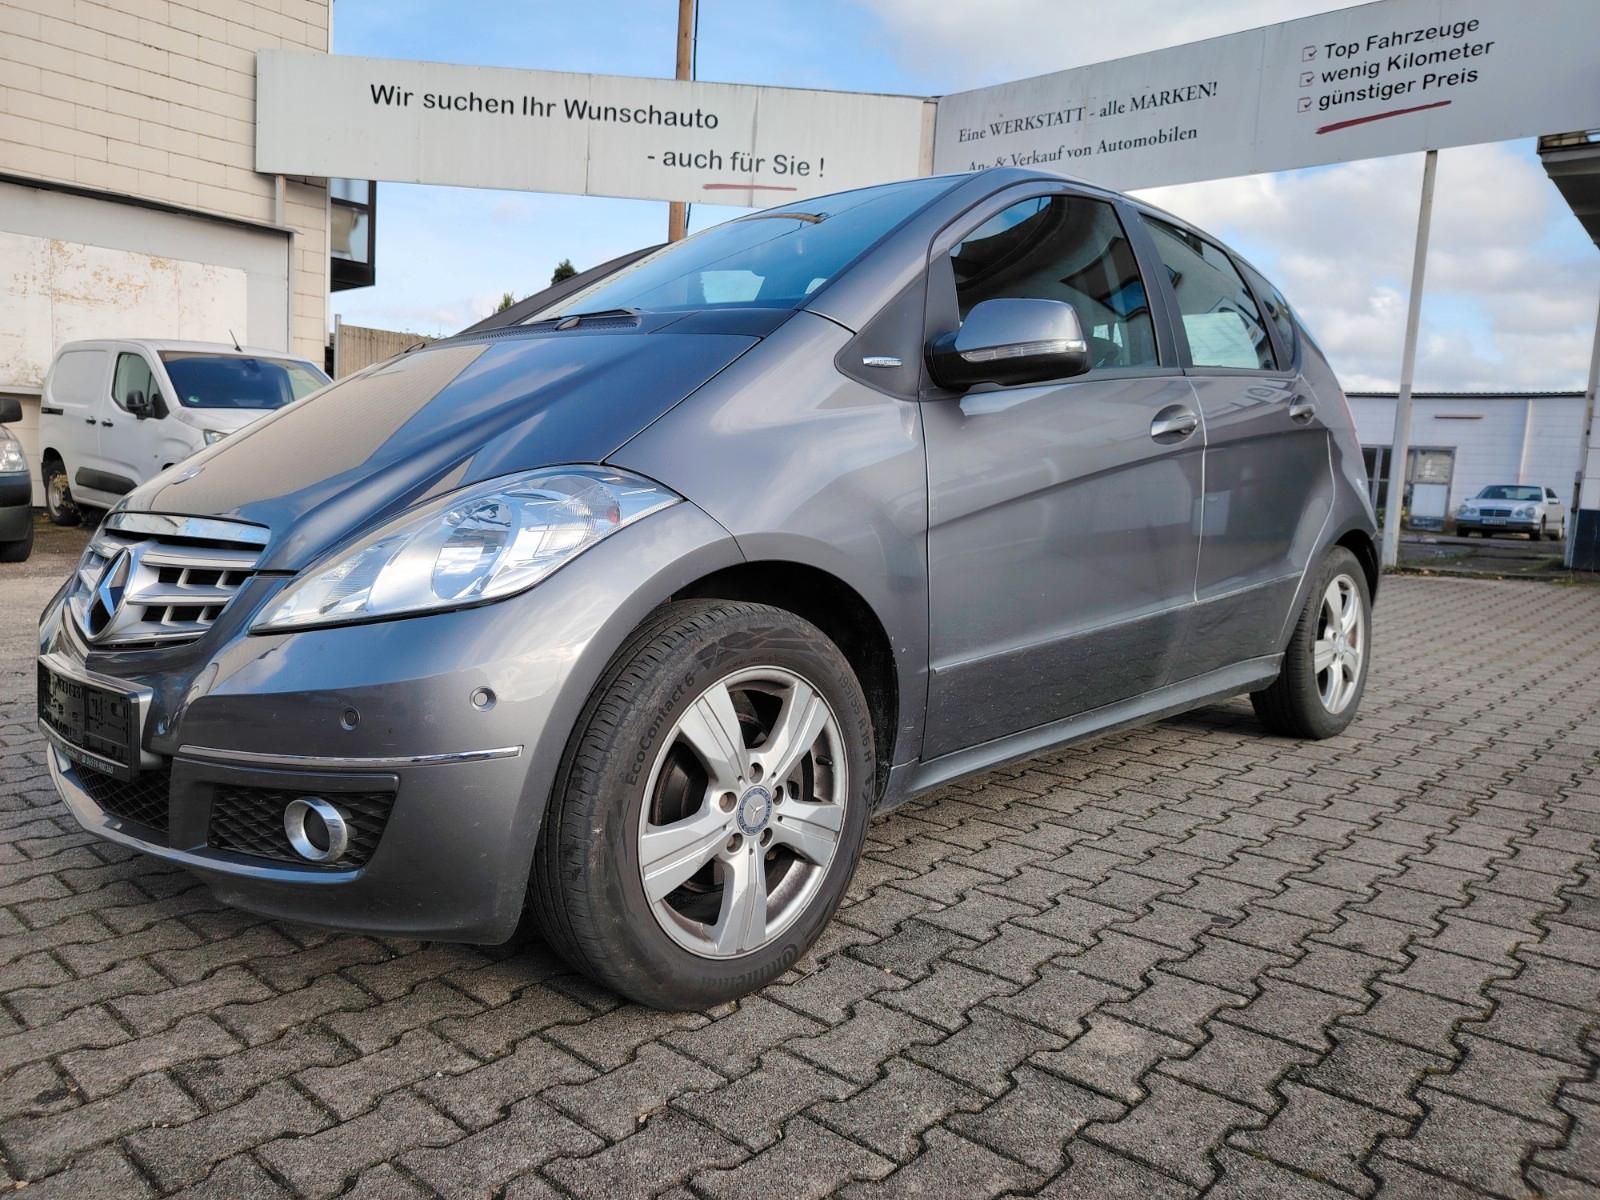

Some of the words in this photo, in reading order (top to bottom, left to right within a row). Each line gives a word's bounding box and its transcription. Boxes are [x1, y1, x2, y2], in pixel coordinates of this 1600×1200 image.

[1324, 42, 1360, 60] Top
[1366, 18, 1480, 51] Fahrzeuge
[1321, 60, 1380, 84] wenig
[1387, 40, 1496, 72] Kilometer
[370, 83, 415, 107] Wir
[423, 91, 515, 115] suchen
[522, 95, 557, 118] Ihr
[563, 98, 719, 130] Wunschauto
[1318, 80, 1417, 111] günstiger
[1422, 68, 1479, 91] Preis
[958, 128, 986, 143] Eine
[989, 106, 1087, 137] WERKSTATT
[1099, 99, 1126, 118] alle
[1130, 81, 1218, 112] MARKEN!
[662, 149, 723, 171] auch
[729, 151, 766, 173] für
[772, 154, 811, 177] Sie
[994, 156, 1007, 168] &
[1011, 145, 1066, 166] Verkauf
[1066, 146, 1092, 158] von
[1096, 125, 1198, 155] Automobilen
[624, 683, 687, 786] EcoContact
[684, 671, 697, 688] 6
